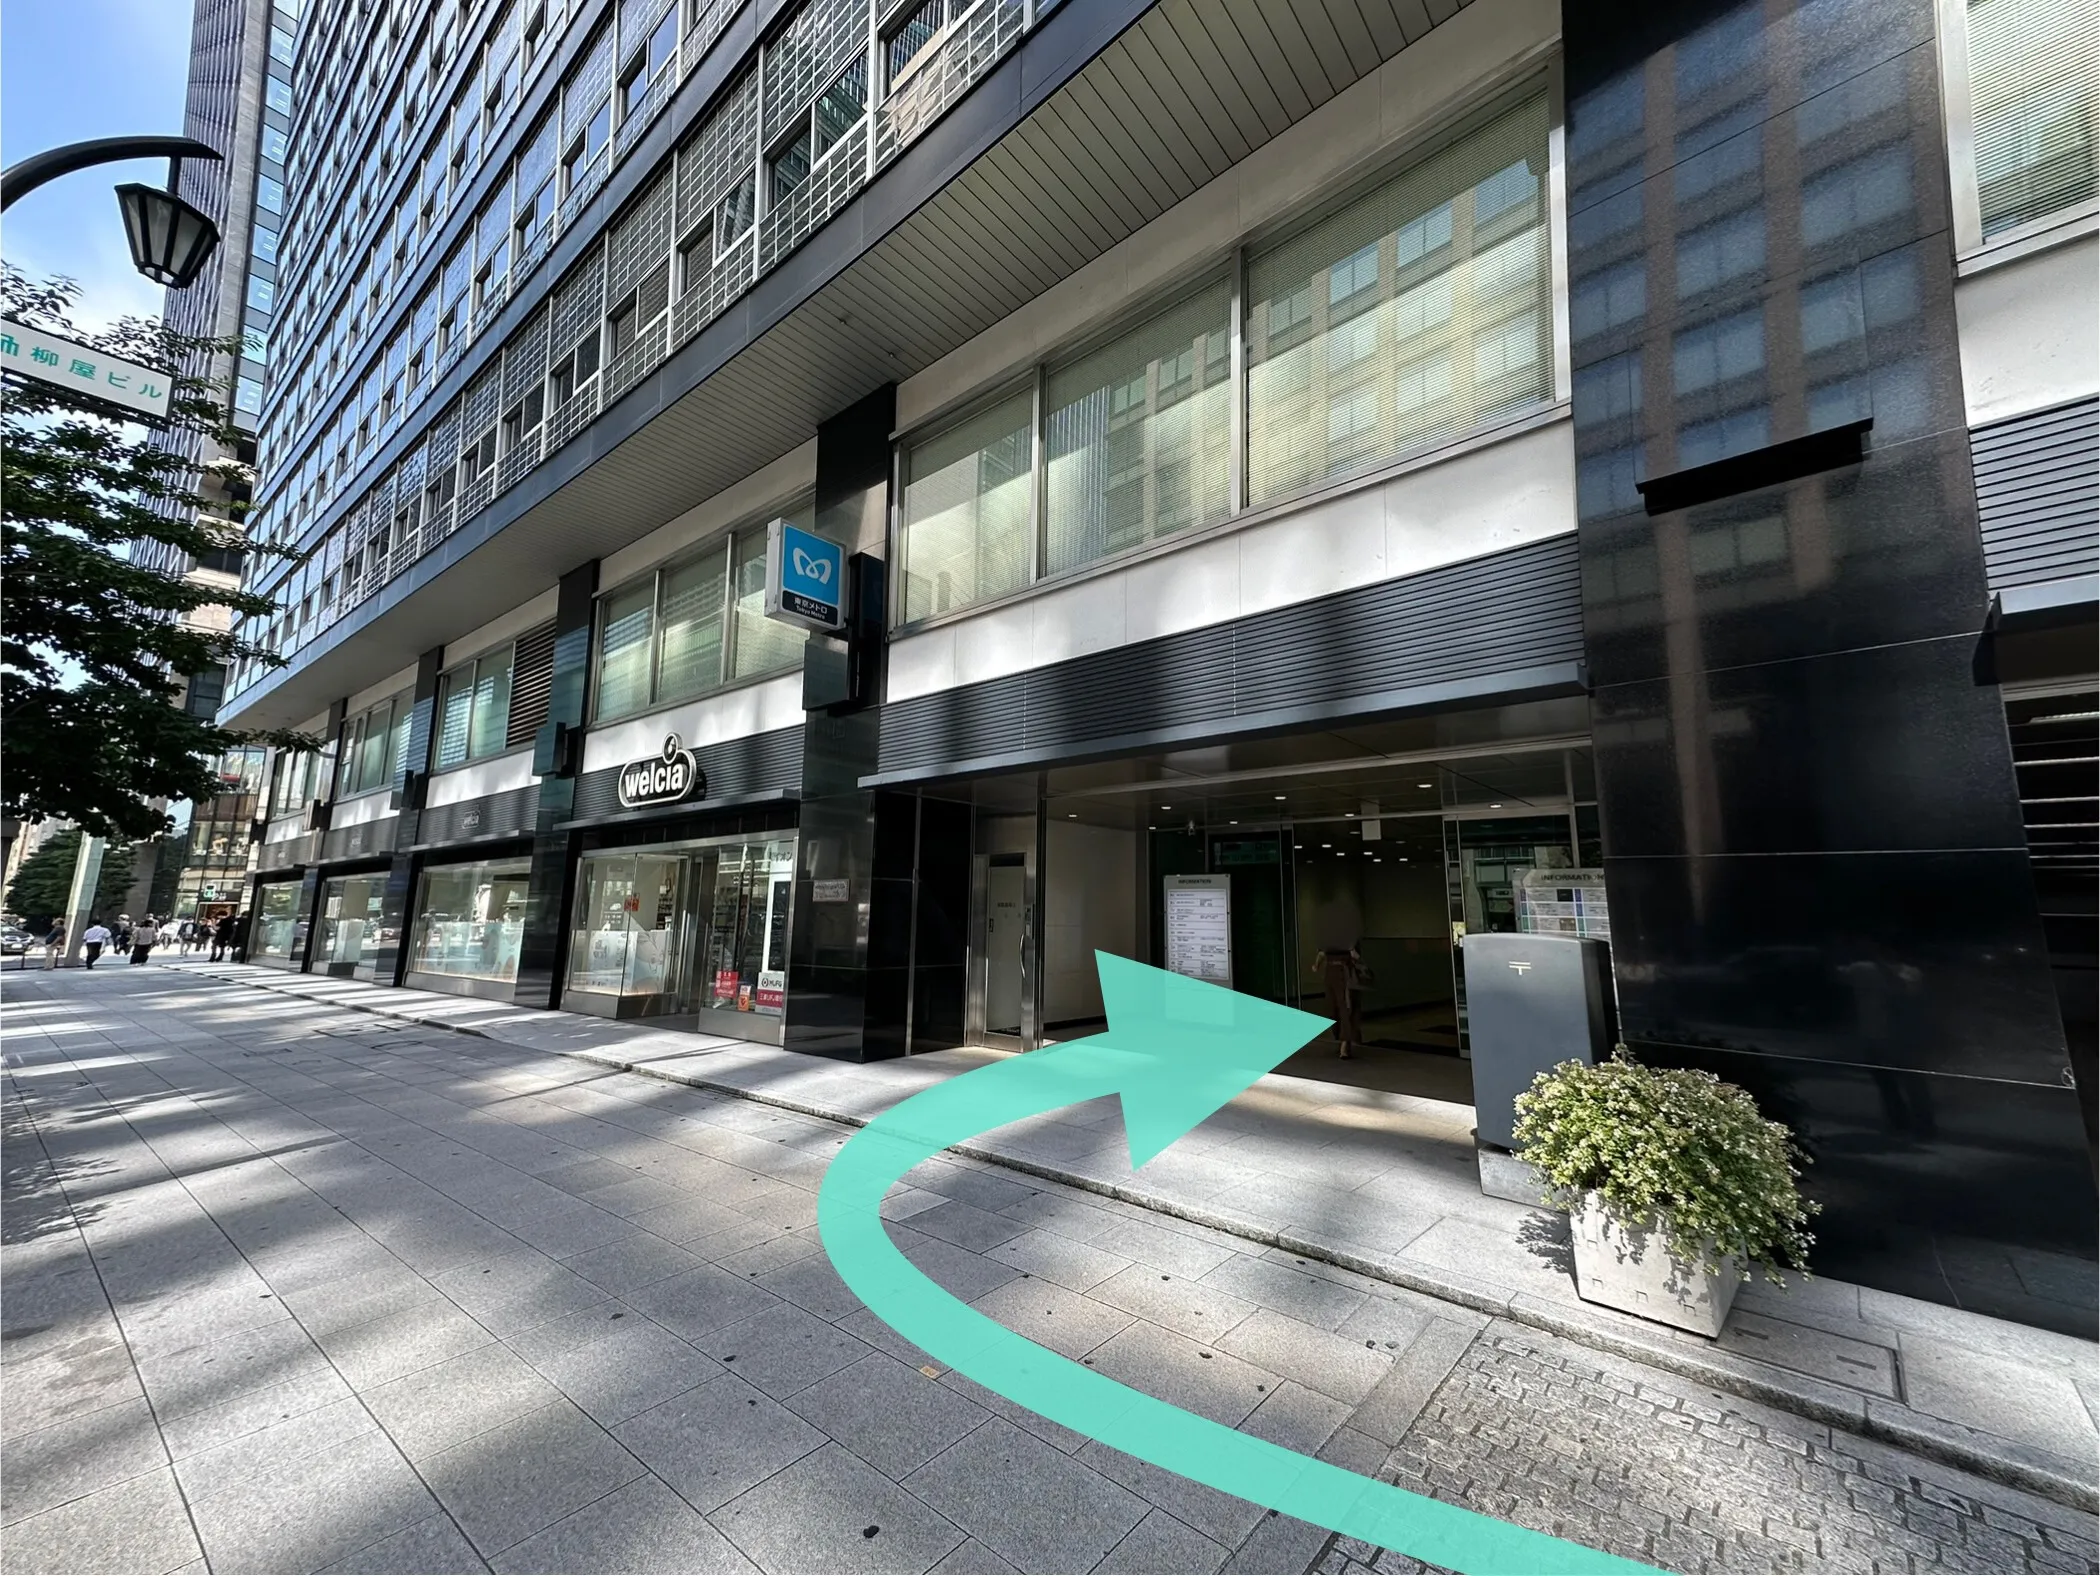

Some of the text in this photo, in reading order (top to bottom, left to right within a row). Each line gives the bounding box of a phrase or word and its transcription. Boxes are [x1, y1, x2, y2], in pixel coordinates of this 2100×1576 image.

[30, 346, 162, 399] 柳屋ビル
[794, 597, 828, 614] 東京メトロ
[796, 605, 826, 620] Tokyo Metro
[625, 762, 684, 798] welcia
